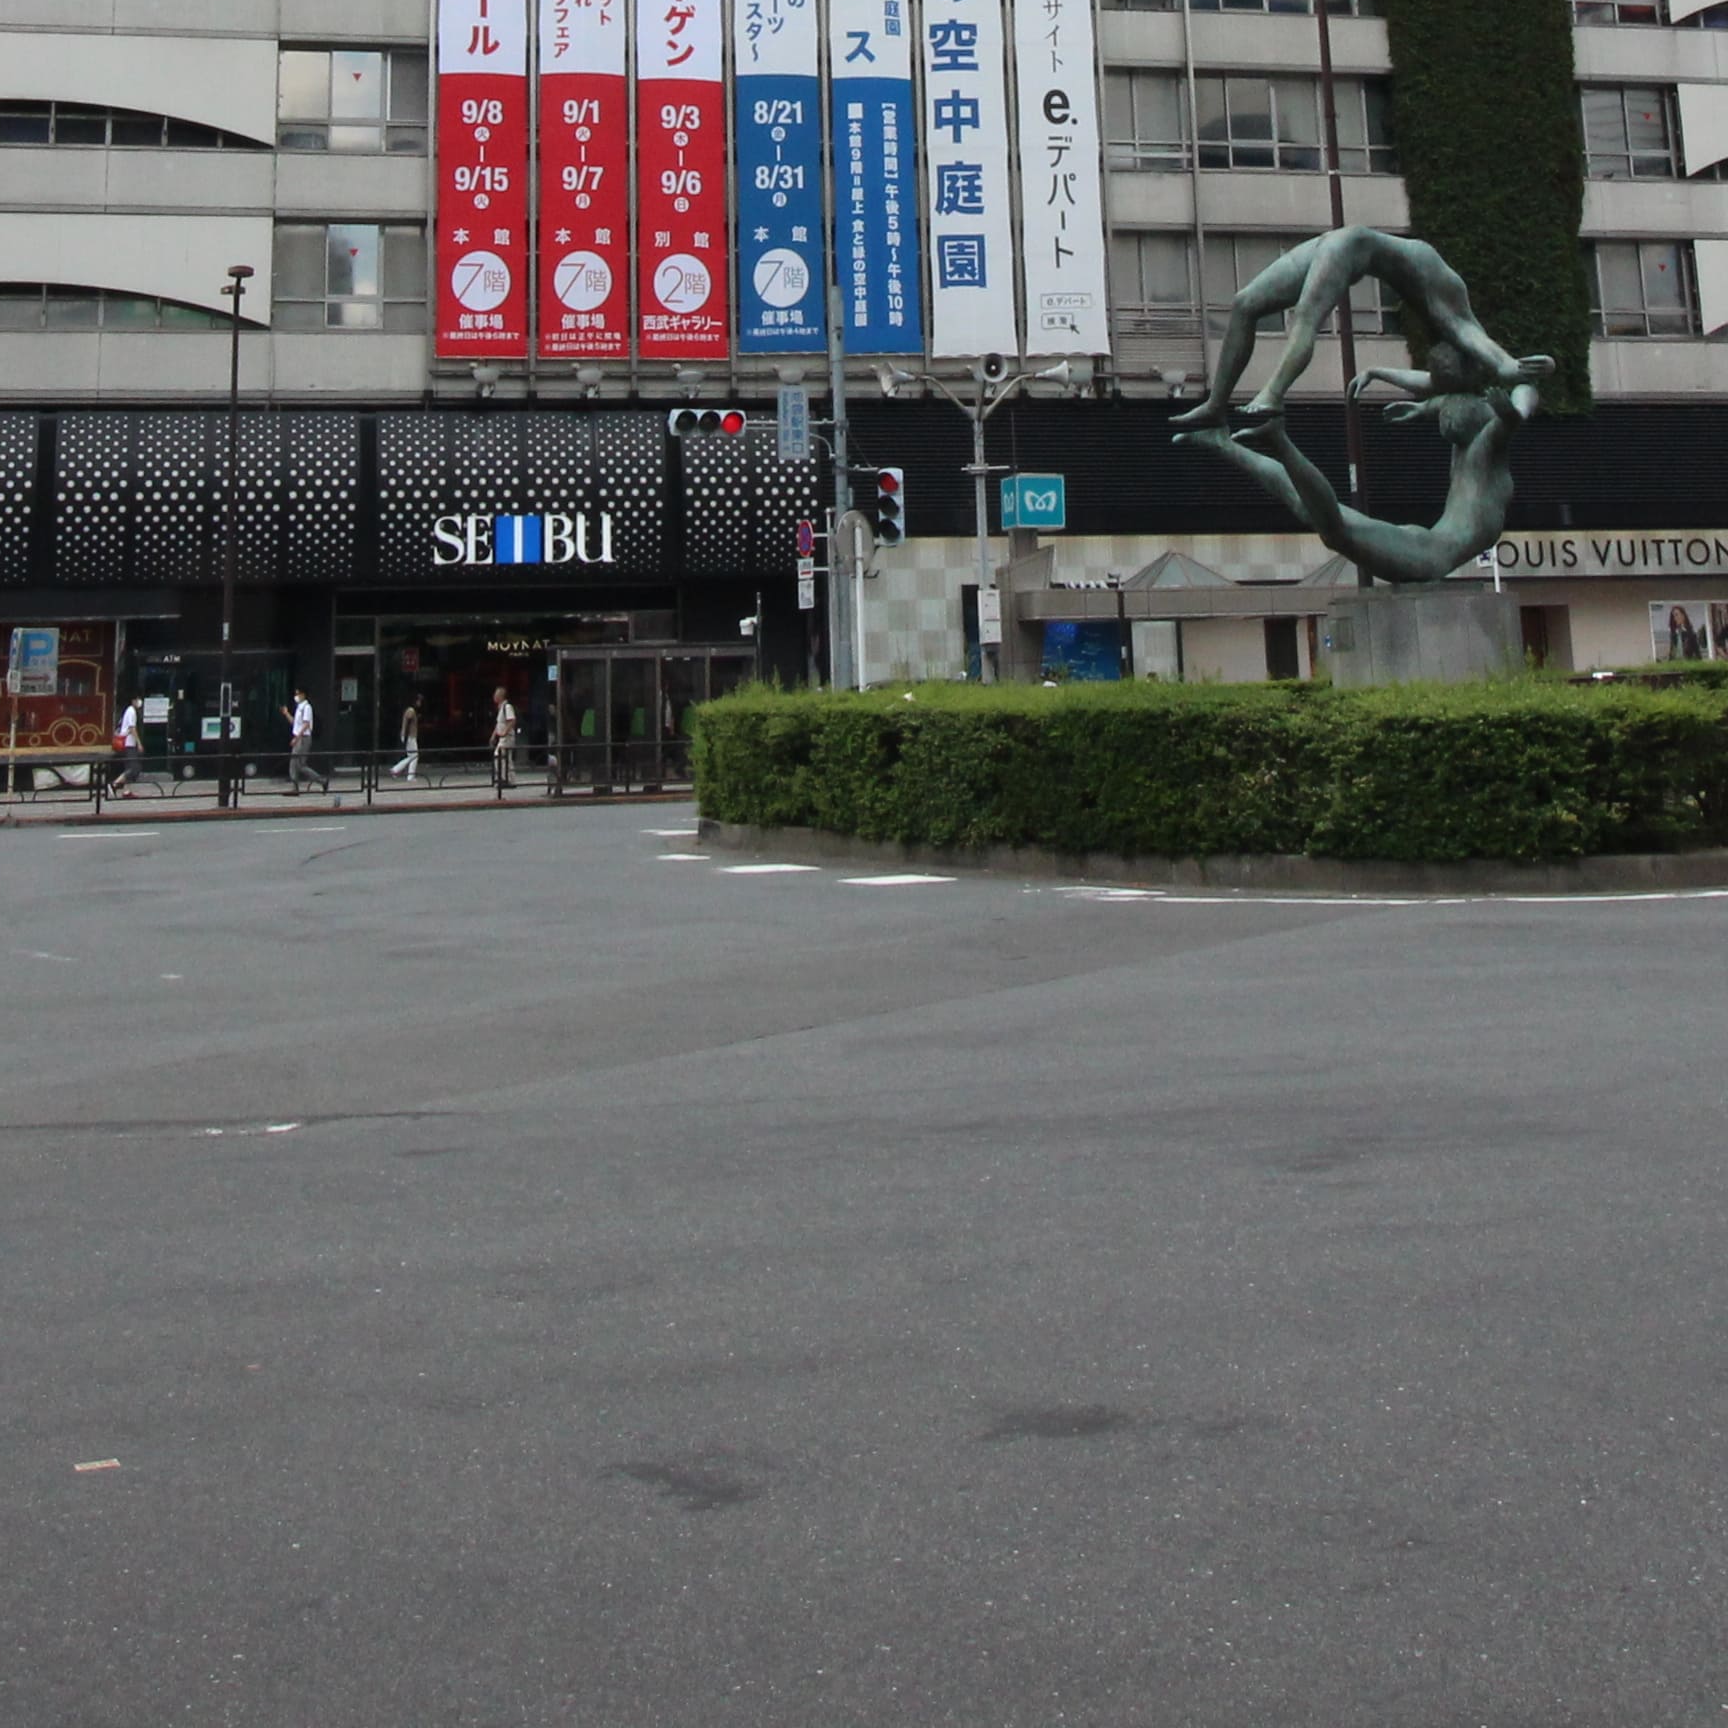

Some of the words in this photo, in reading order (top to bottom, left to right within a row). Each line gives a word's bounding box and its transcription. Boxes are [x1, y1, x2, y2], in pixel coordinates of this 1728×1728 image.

[462, 99, 503, 124] 9/8
[563, 99, 600, 124] 9/1
[661, 105, 700, 130] 9/3
[754, 100, 803, 124] 8/21
[454, 166, 509, 191] 9/15
[562, 166, 603, 191] 9/7
[661, 171, 701, 195] 9/6
[755, 165, 804, 190] 8/31
[458, 263, 506, 300] 7階
[560, 263, 607, 300] 7階
[662, 266, 706, 303] 2階
[760, 261, 804, 299] 7階
[459, 314, 503, 329] 催事場
[561, 314, 605, 329] 催事場
[643, 315, 723, 331] 西武ギャラリー
[762, 310, 804, 326] 催事場
[434, 513, 614, 564] SEIBU
[1496, 540, 1578, 568] OUIS
[23, 633, 54, 666] P
